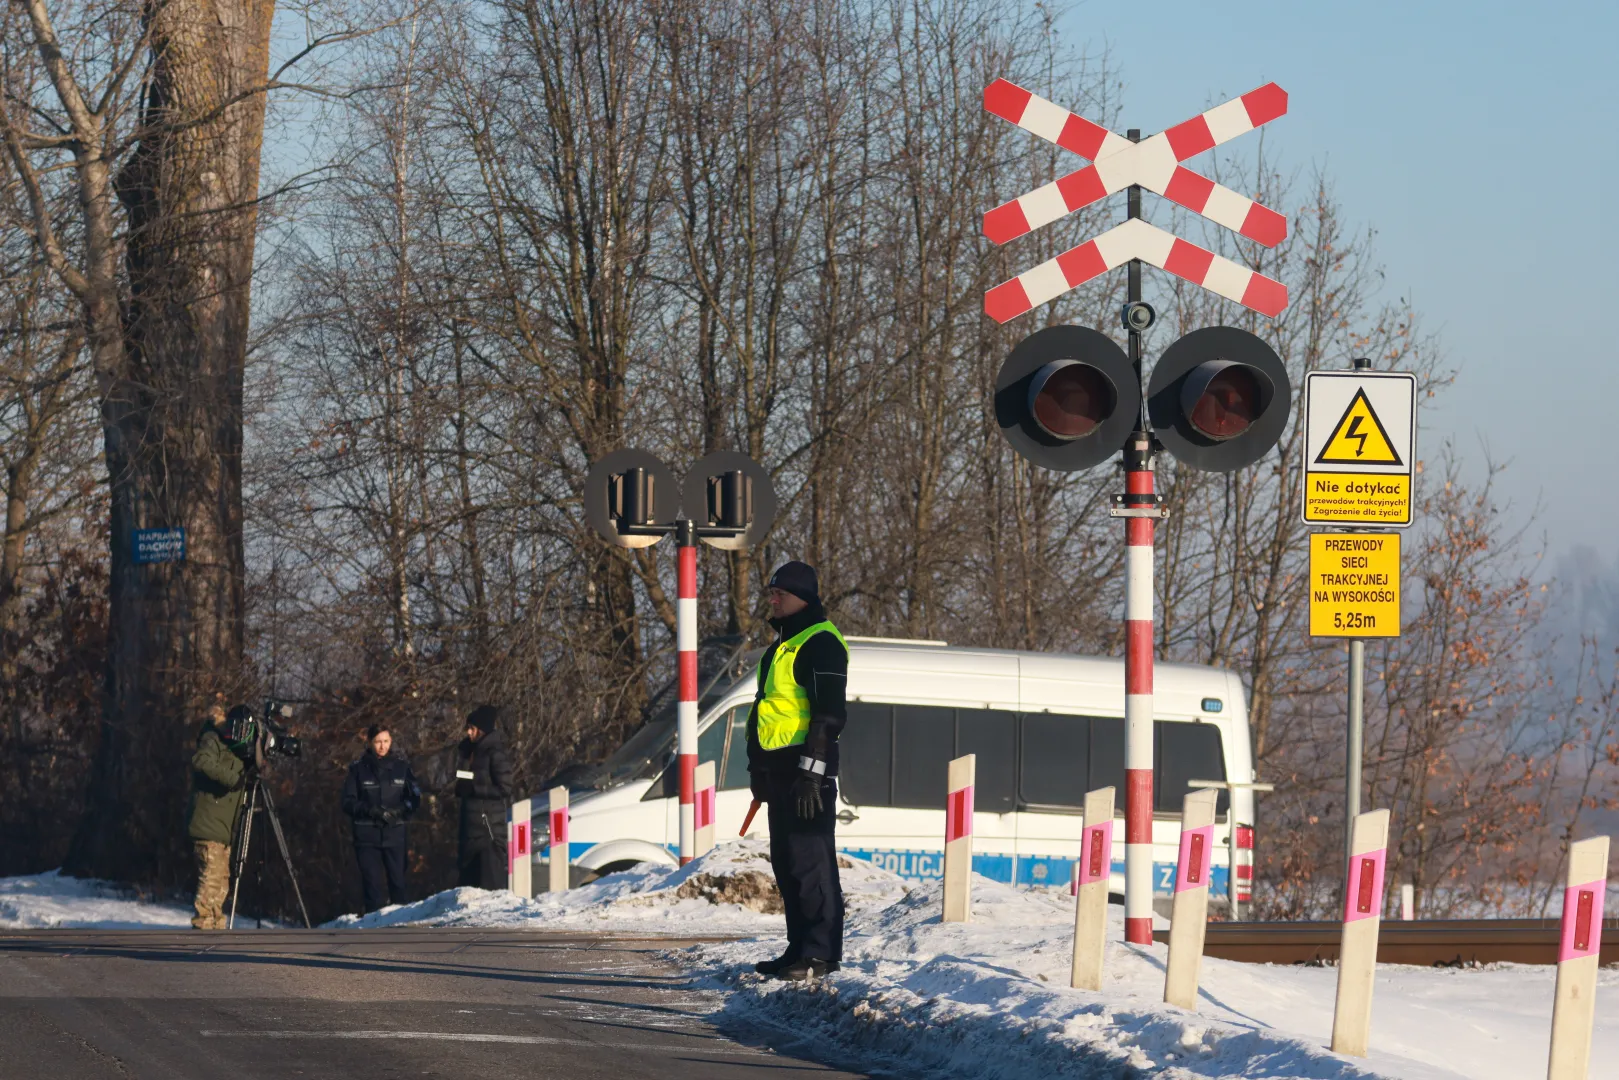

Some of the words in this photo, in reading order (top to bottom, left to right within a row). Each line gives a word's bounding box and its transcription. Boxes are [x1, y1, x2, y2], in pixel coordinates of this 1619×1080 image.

[1316, 480, 1339, 493] Nie
[1345, 481, 1400, 496] dotykać
[1308, 497, 1355, 505] przewodów
[1357, 498, 1406, 507] trakcyjnych!
[1313, 506, 1360, 516] Zagrożenie
[1363, 508, 1376, 516] dla
[1378, 508, 1402, 517] życia!
[1325, 539, 1384, 551] PRZEWODY
[1341, 556, 1368, 568] SIECI
[1320, 573, 1388, 586] TRAKCYJNEJ
[1314, 591, 1329, 602] NA
[1332, 588, 1395, 603] WYSOKOŚCI
[1334, 612, 1376, 631] 5,25m
[871, 853, 944, 878] POLICJ
